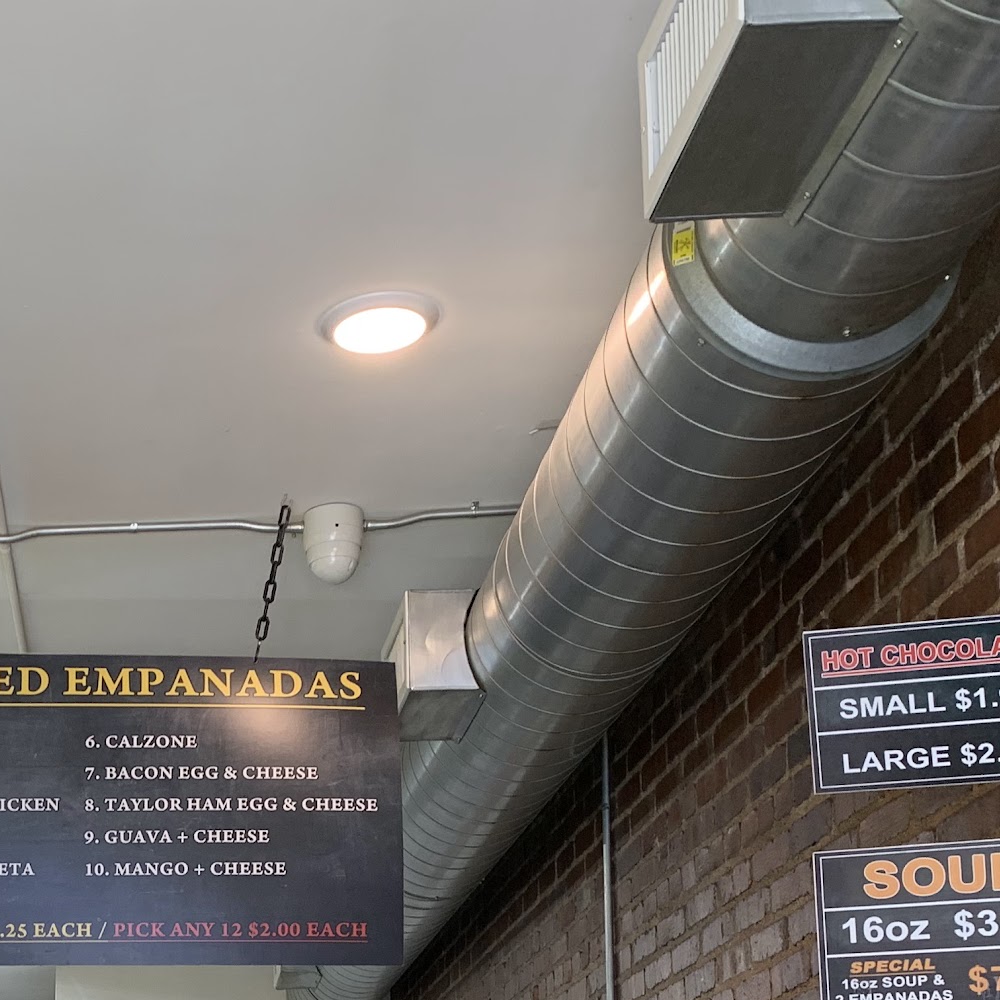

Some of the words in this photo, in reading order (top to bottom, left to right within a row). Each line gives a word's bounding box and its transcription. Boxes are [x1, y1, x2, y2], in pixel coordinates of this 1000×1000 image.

[821, 646, 875, 672] HOT
[62, 667, 362, 700] EMPANADAS
[839, 691, 947, 720] SMALL
[955, 687, 1000, 712] $1.
[85, 735, 100, 749] 6.
[105, 735, 198, 749] CALZONE
[842, 746, 951, 774] LARGE
[85, 767, 100, 781] 7.
[104, 766, 173, 780] BACON
[178, 766, 219, 780] EGG
[223, 766, 237, 780] &
[242, 766, 319, 780] CHEESE
[84, 798, 100, 812] 8.
[104, 798, 183, 812] TAYLOR
[187, 798, 232, 812] HAM
[237, 797, 277, 812] EGG
[282, 797, 297, 812] &
[301, 797, 378, 812] CHEESE
[84, 831, 99, 845] 9.
[104, 830, 173, 845] GUAVA
[177, 832, 189, 843] +
[193, 829, 270, 844] CHEESE
[85, 863, 110, 877] 10.
[114, 862, 189, 877] MANGO
[193, 864, 205, 875] +
[210, 861, 287, 876] CHEESE
[862, 852, 1000, 899] SOU
[34, 923, 92, 938] EACH
[98, 921, 107, 939] /
[113, 922, 167, 937] PICK
[171, 922, 216, 937] ANY
[222, 922, 242, 937] 12
[249, 922, 300, 938] $2.00
[306, 922, 368, 937] EACH
[841, 915, 930, 944] 16oz
[850, 958, 936, 975] SPECIAL
[841, 976, 878, 990] 16oz
[881, 975, 928, 988] SOUP
[933, 974, 945, 987] &
